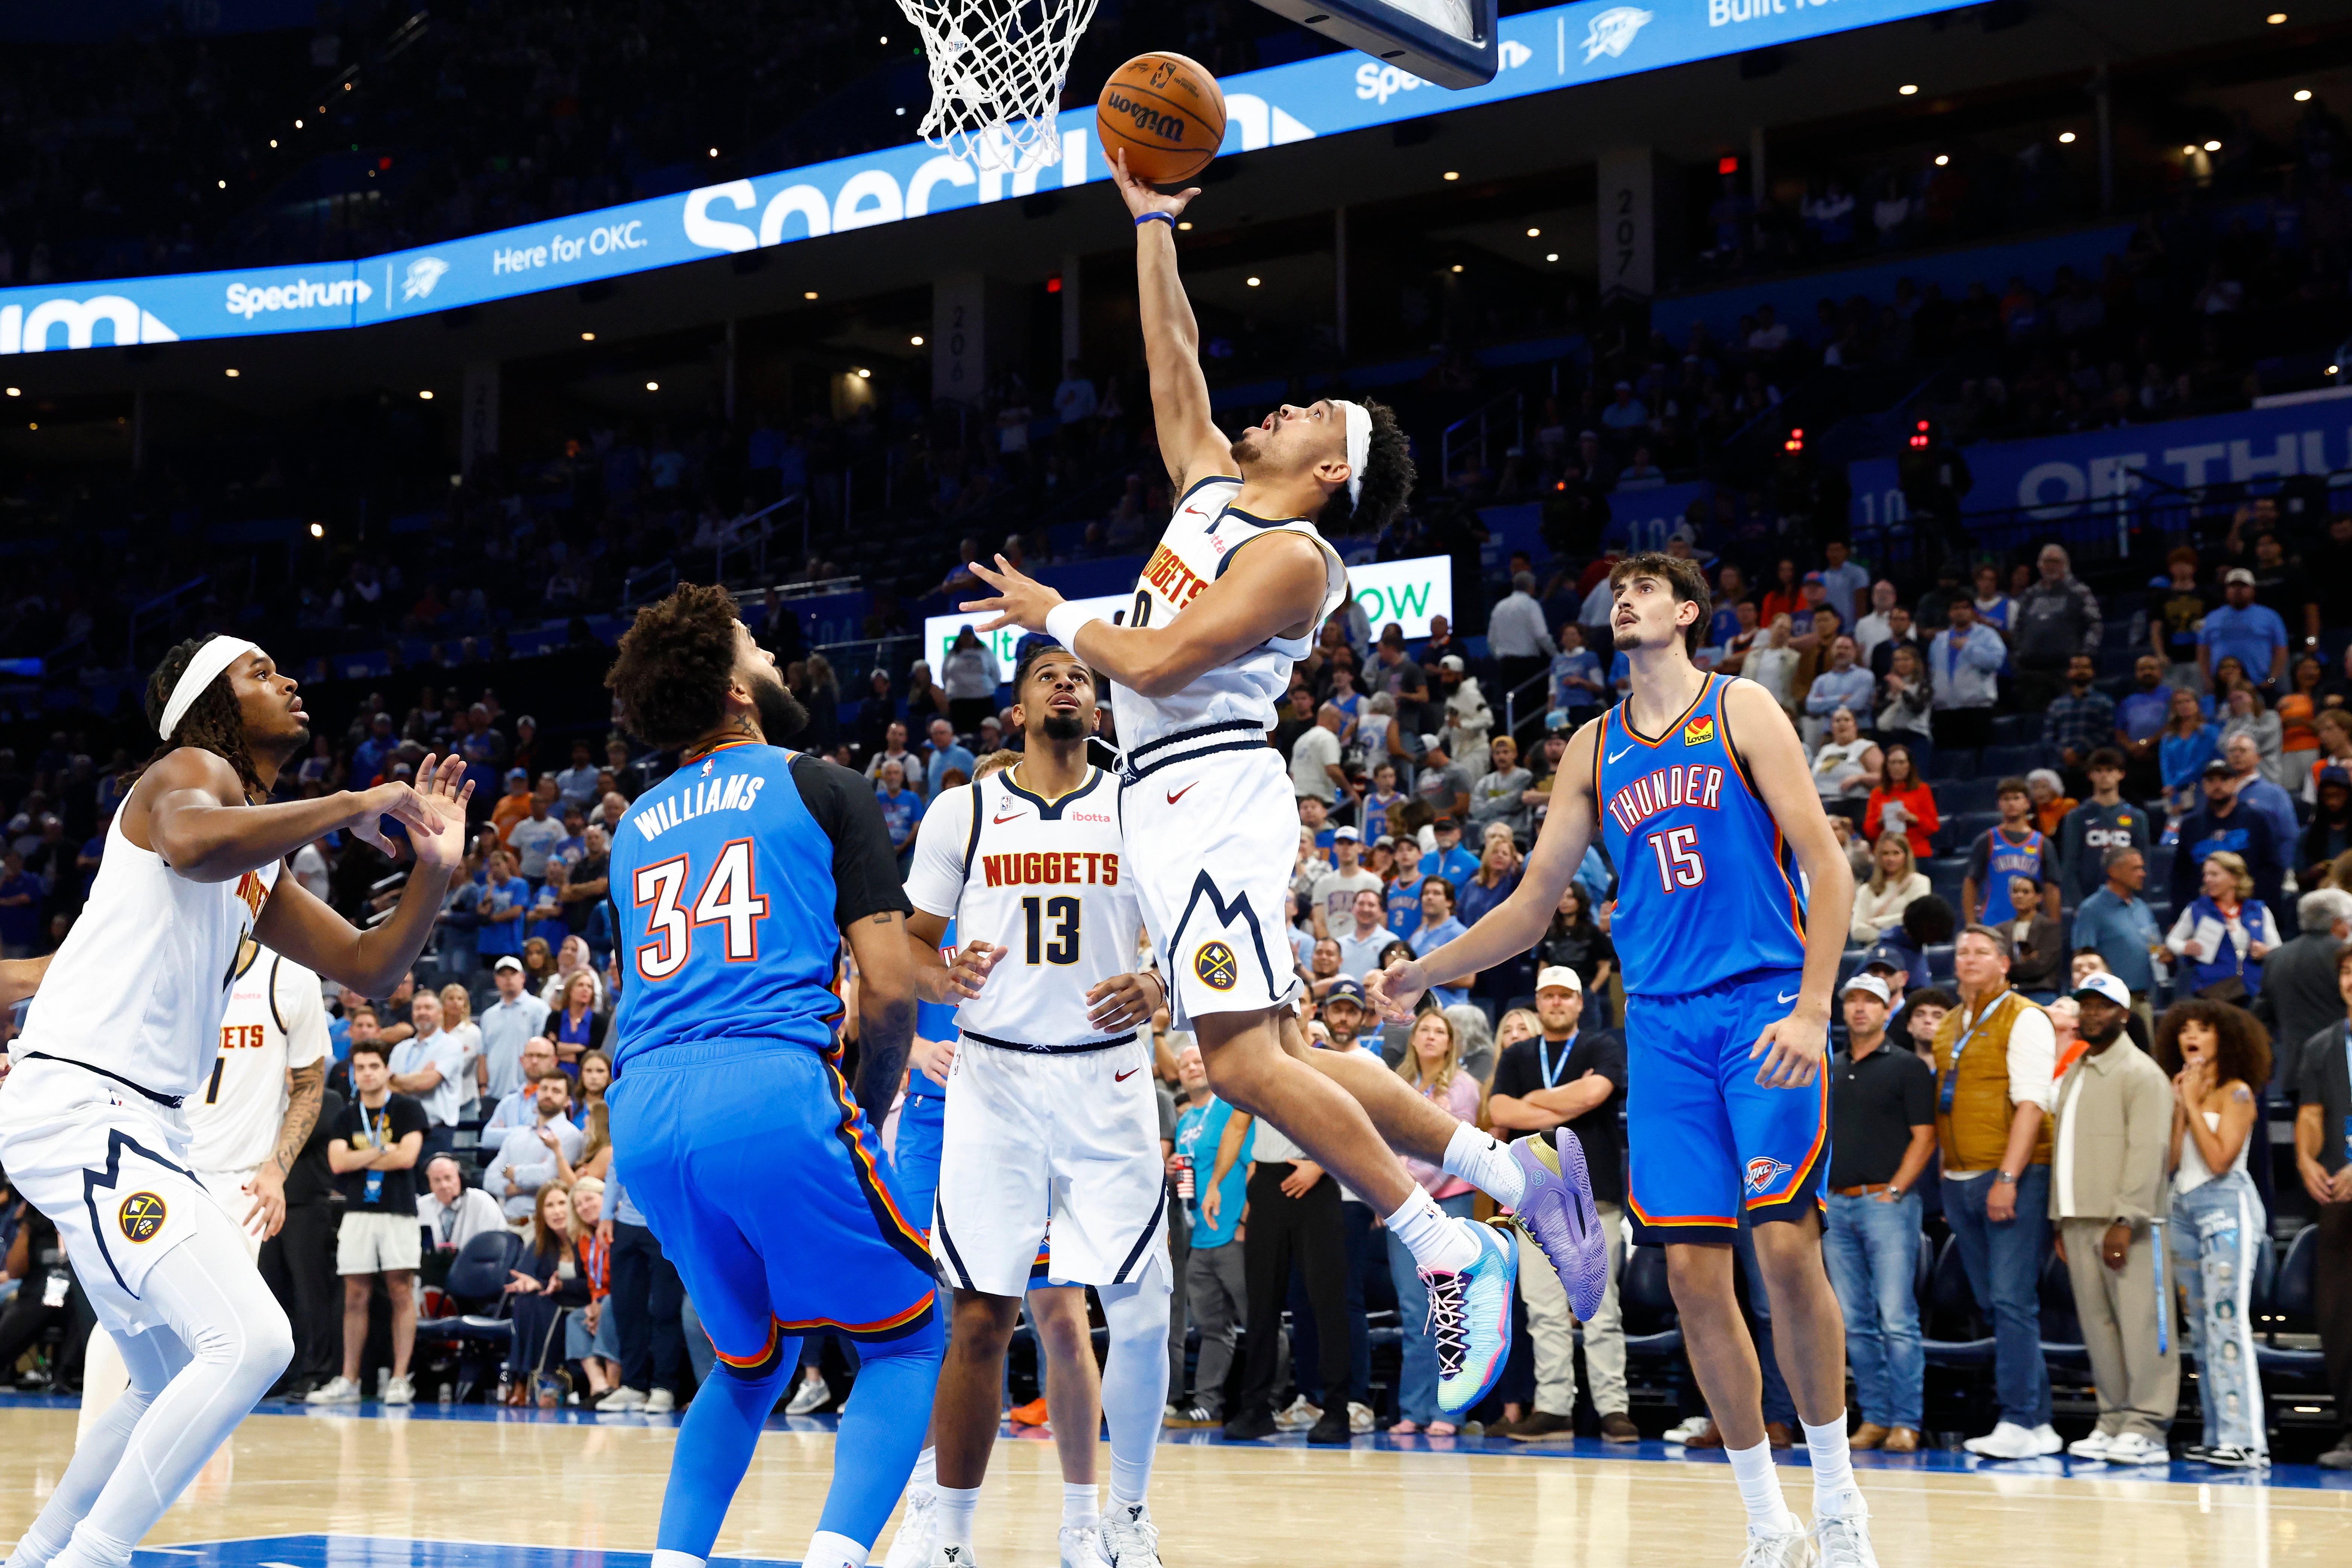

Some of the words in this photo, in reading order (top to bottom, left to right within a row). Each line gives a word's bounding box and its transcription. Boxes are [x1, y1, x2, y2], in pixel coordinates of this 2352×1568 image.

[1108, 91, 1185, 143] Wilson
[493, 244, 546, 275] Here
[552, 236, 582, 264] for
[589, 220, 648, 256] OKC.
[1617, 189, 1633, 277] 207
[226, 278, 360, 320] Spectrum
[2018, 453, 2147, 520] OF
[634, 774, 764, 842] WILLIAMS
[1073, 811, 1110, 822] ibotta
[1609, 764, 1724, 836] THUNDER
[982, 852, 1119, 888] NUGGETS
[1648, 825, 1705, 894] 15
[633, 836, 770, 982] 34
[1021, 896, 1080, 966] 13
[1749, 1164, 1771, 1185] OKC
